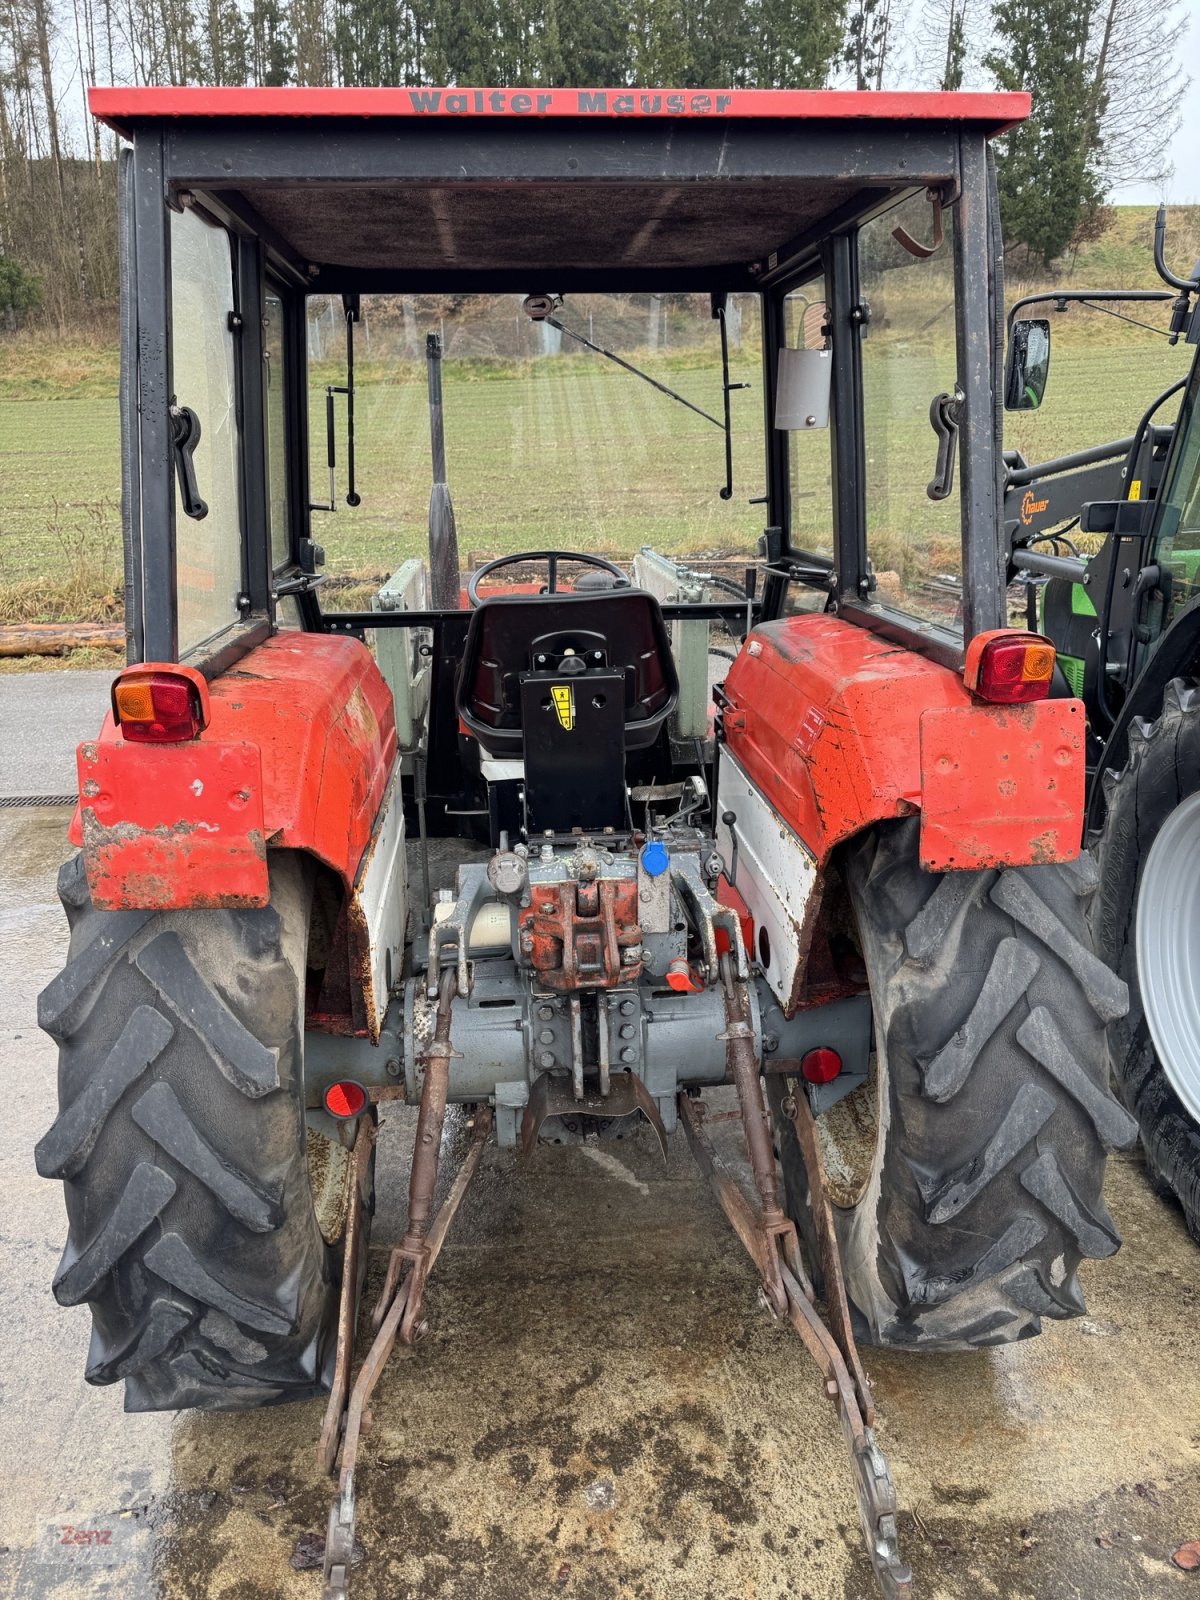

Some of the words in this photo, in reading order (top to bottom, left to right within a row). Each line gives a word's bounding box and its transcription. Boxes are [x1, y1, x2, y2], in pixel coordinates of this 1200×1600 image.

[408, 91, 552, 113] Walter
[577, 91, 732, 114] Mauser
[1025, 498, 1049, 514] hauer
